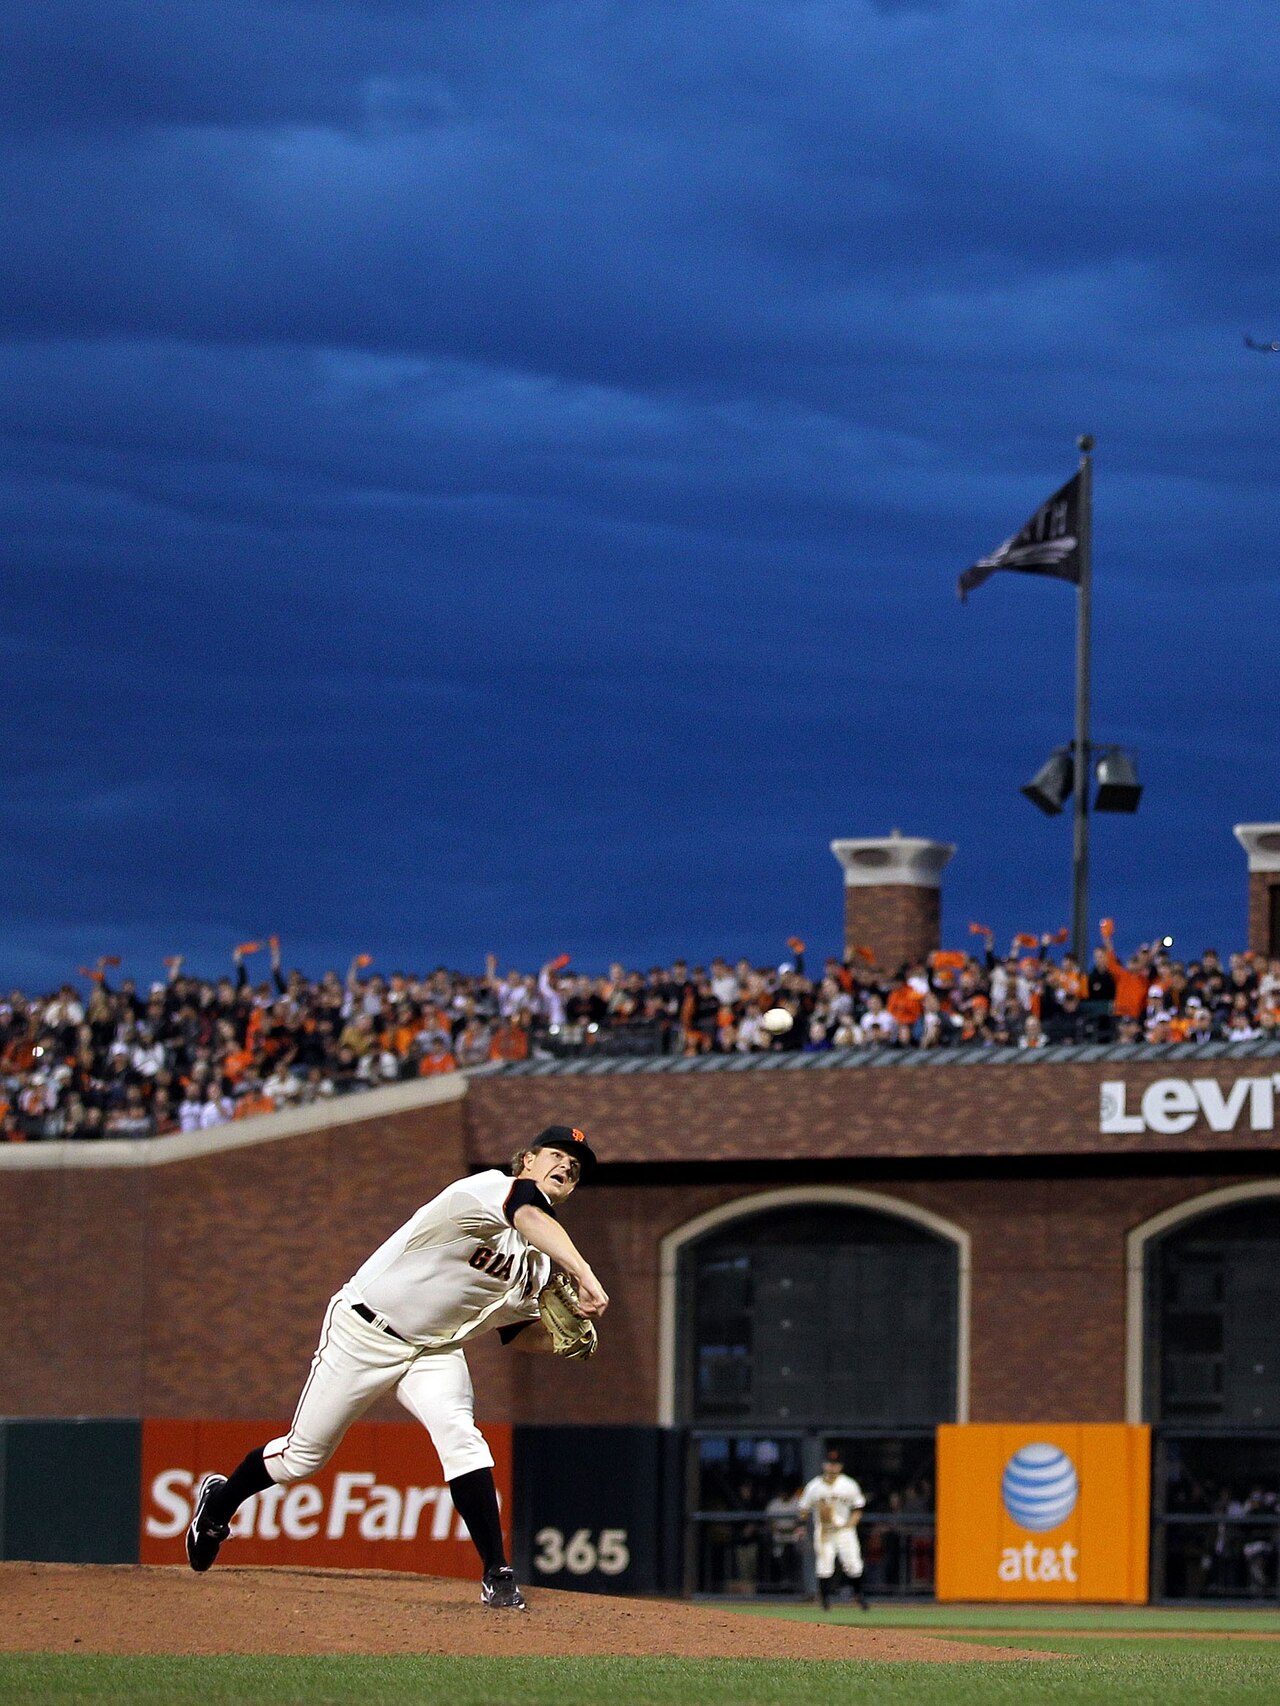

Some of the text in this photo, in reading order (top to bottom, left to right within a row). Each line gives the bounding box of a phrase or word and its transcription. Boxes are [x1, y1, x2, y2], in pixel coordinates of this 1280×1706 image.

[145, 1468, 324, 1541] Sate
[534, 1526, 630, 1575] 365
[998, 1540, 1079, 1583] at&t
